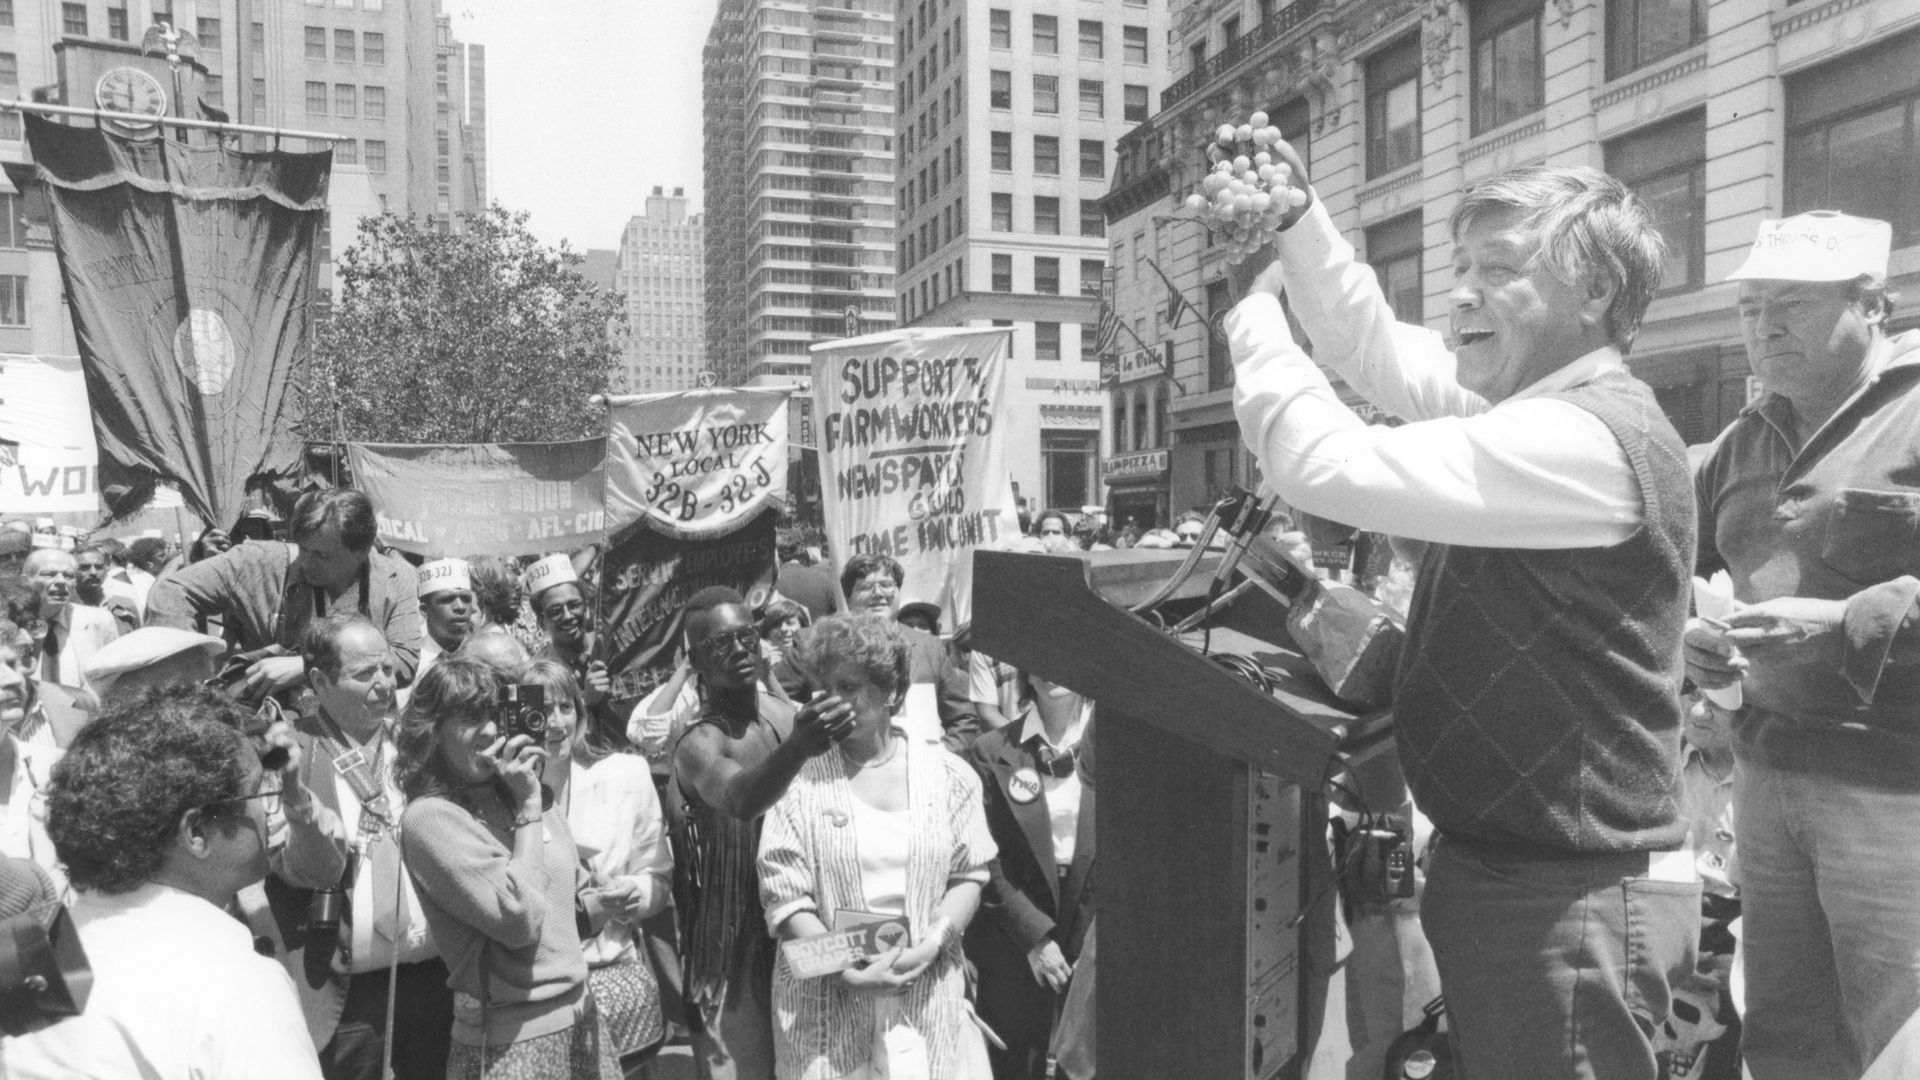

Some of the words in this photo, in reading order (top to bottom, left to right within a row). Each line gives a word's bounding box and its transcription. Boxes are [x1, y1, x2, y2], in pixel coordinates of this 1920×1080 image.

[841, 356, 958, 404] SUPPORT
[634, 431, 700, 459] NEW
[708, 422, 775, 450] YORK
[824, 399, 993, 453] FARMWORKERS
[18, 464, 99, 497] WO
[671, 453, 741, 478] LOCAL
[645, 456, 772, 521] 32B-32J
[850, 525, 909, 557] TIME
[787, 929, 867, 959] BOYCOTT
[797, 947, 864, 973] GRAPES
